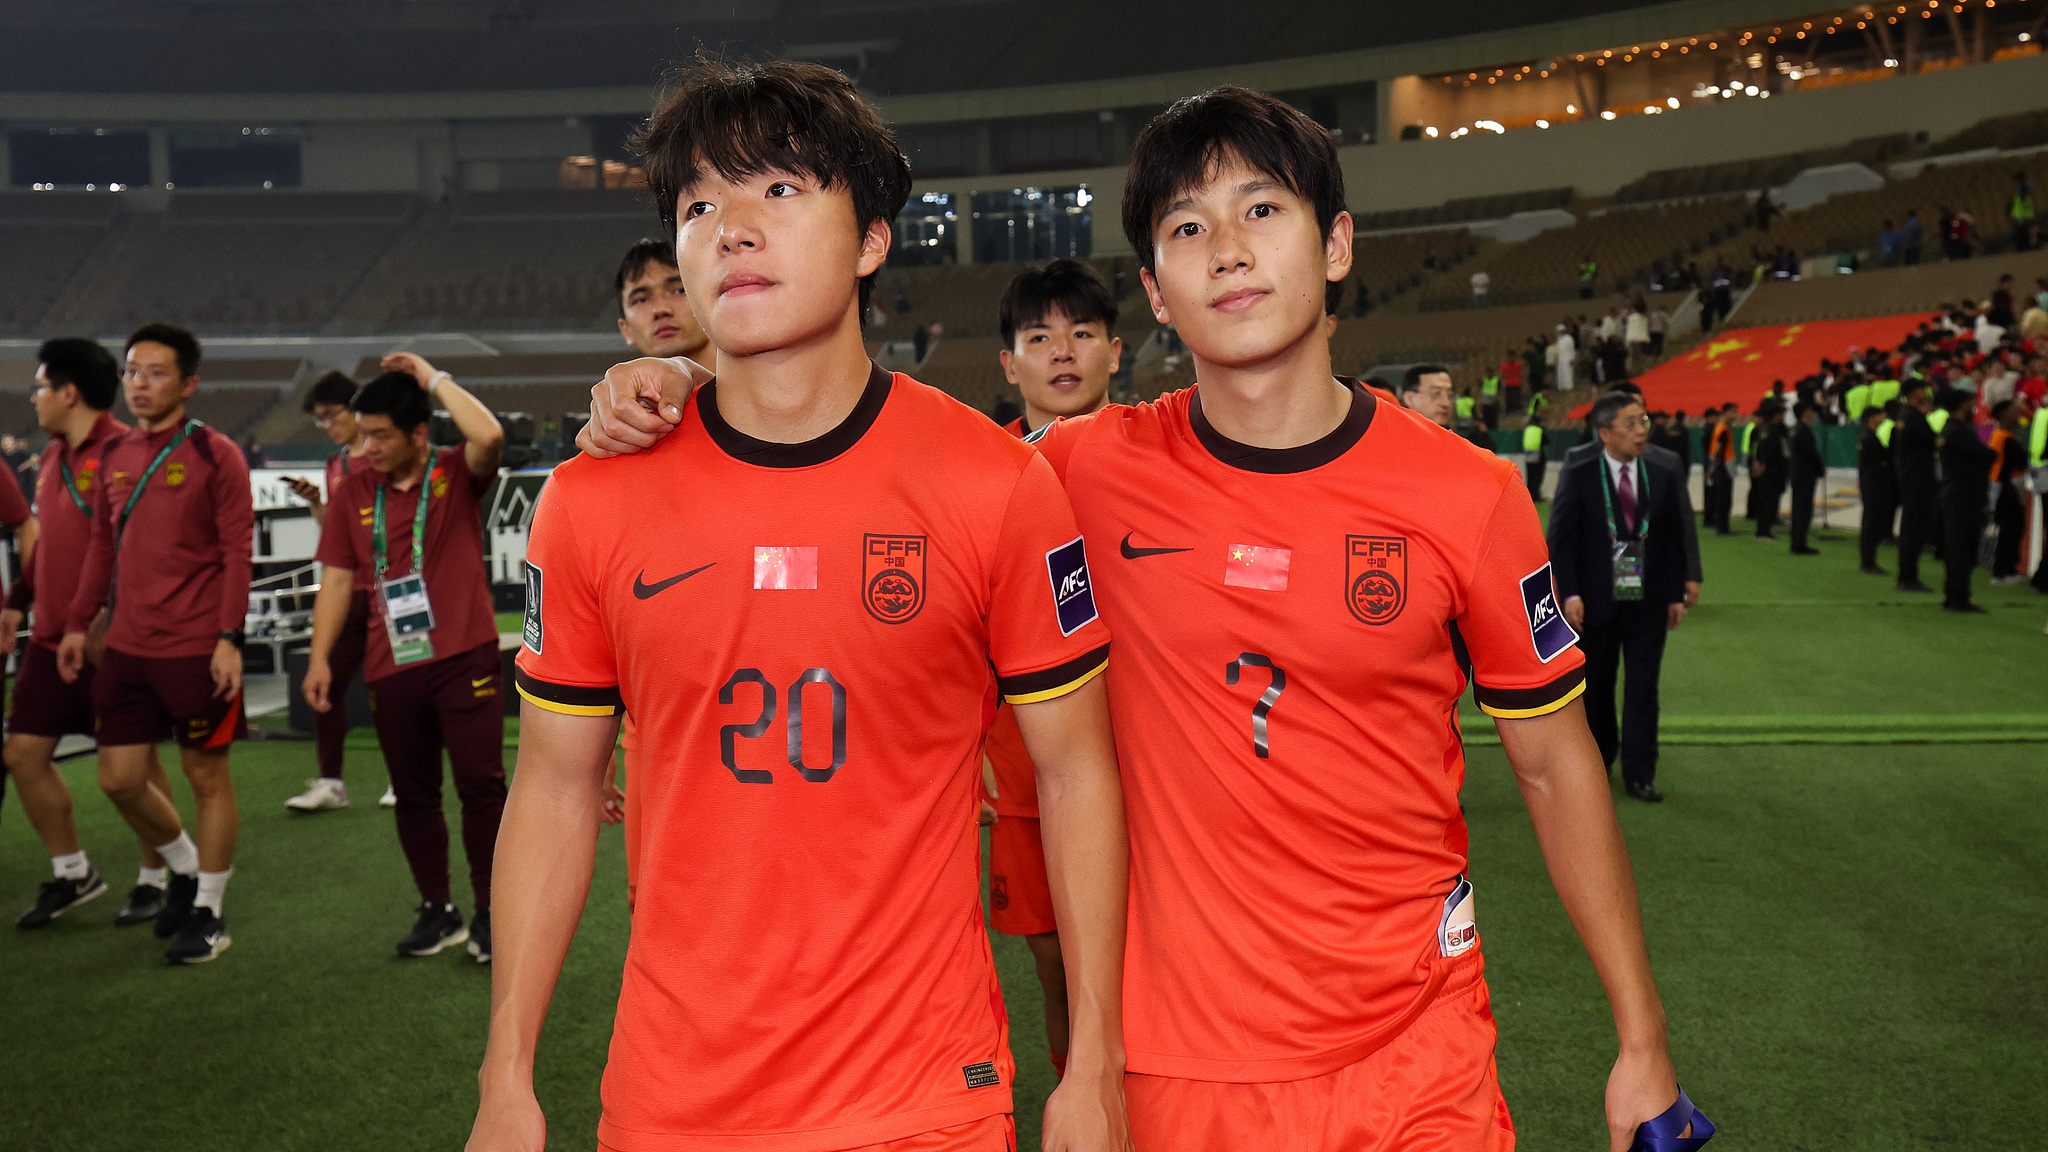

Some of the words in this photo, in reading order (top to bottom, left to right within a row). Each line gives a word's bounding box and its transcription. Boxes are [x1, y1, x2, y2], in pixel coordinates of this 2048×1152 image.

[869, 540, 921, 556] CFA
[1352, 541, 1402, 557] CFA
[884, 556, 905, 568] 中国
[1367, 557, 1387, 569] 中国
[1058, 565, 1086, 600] AFC
[1533, 592, 1555, 628] AFC
[1226, 652, 1286, 759] 7
[718, 667, 847, 784] 20
